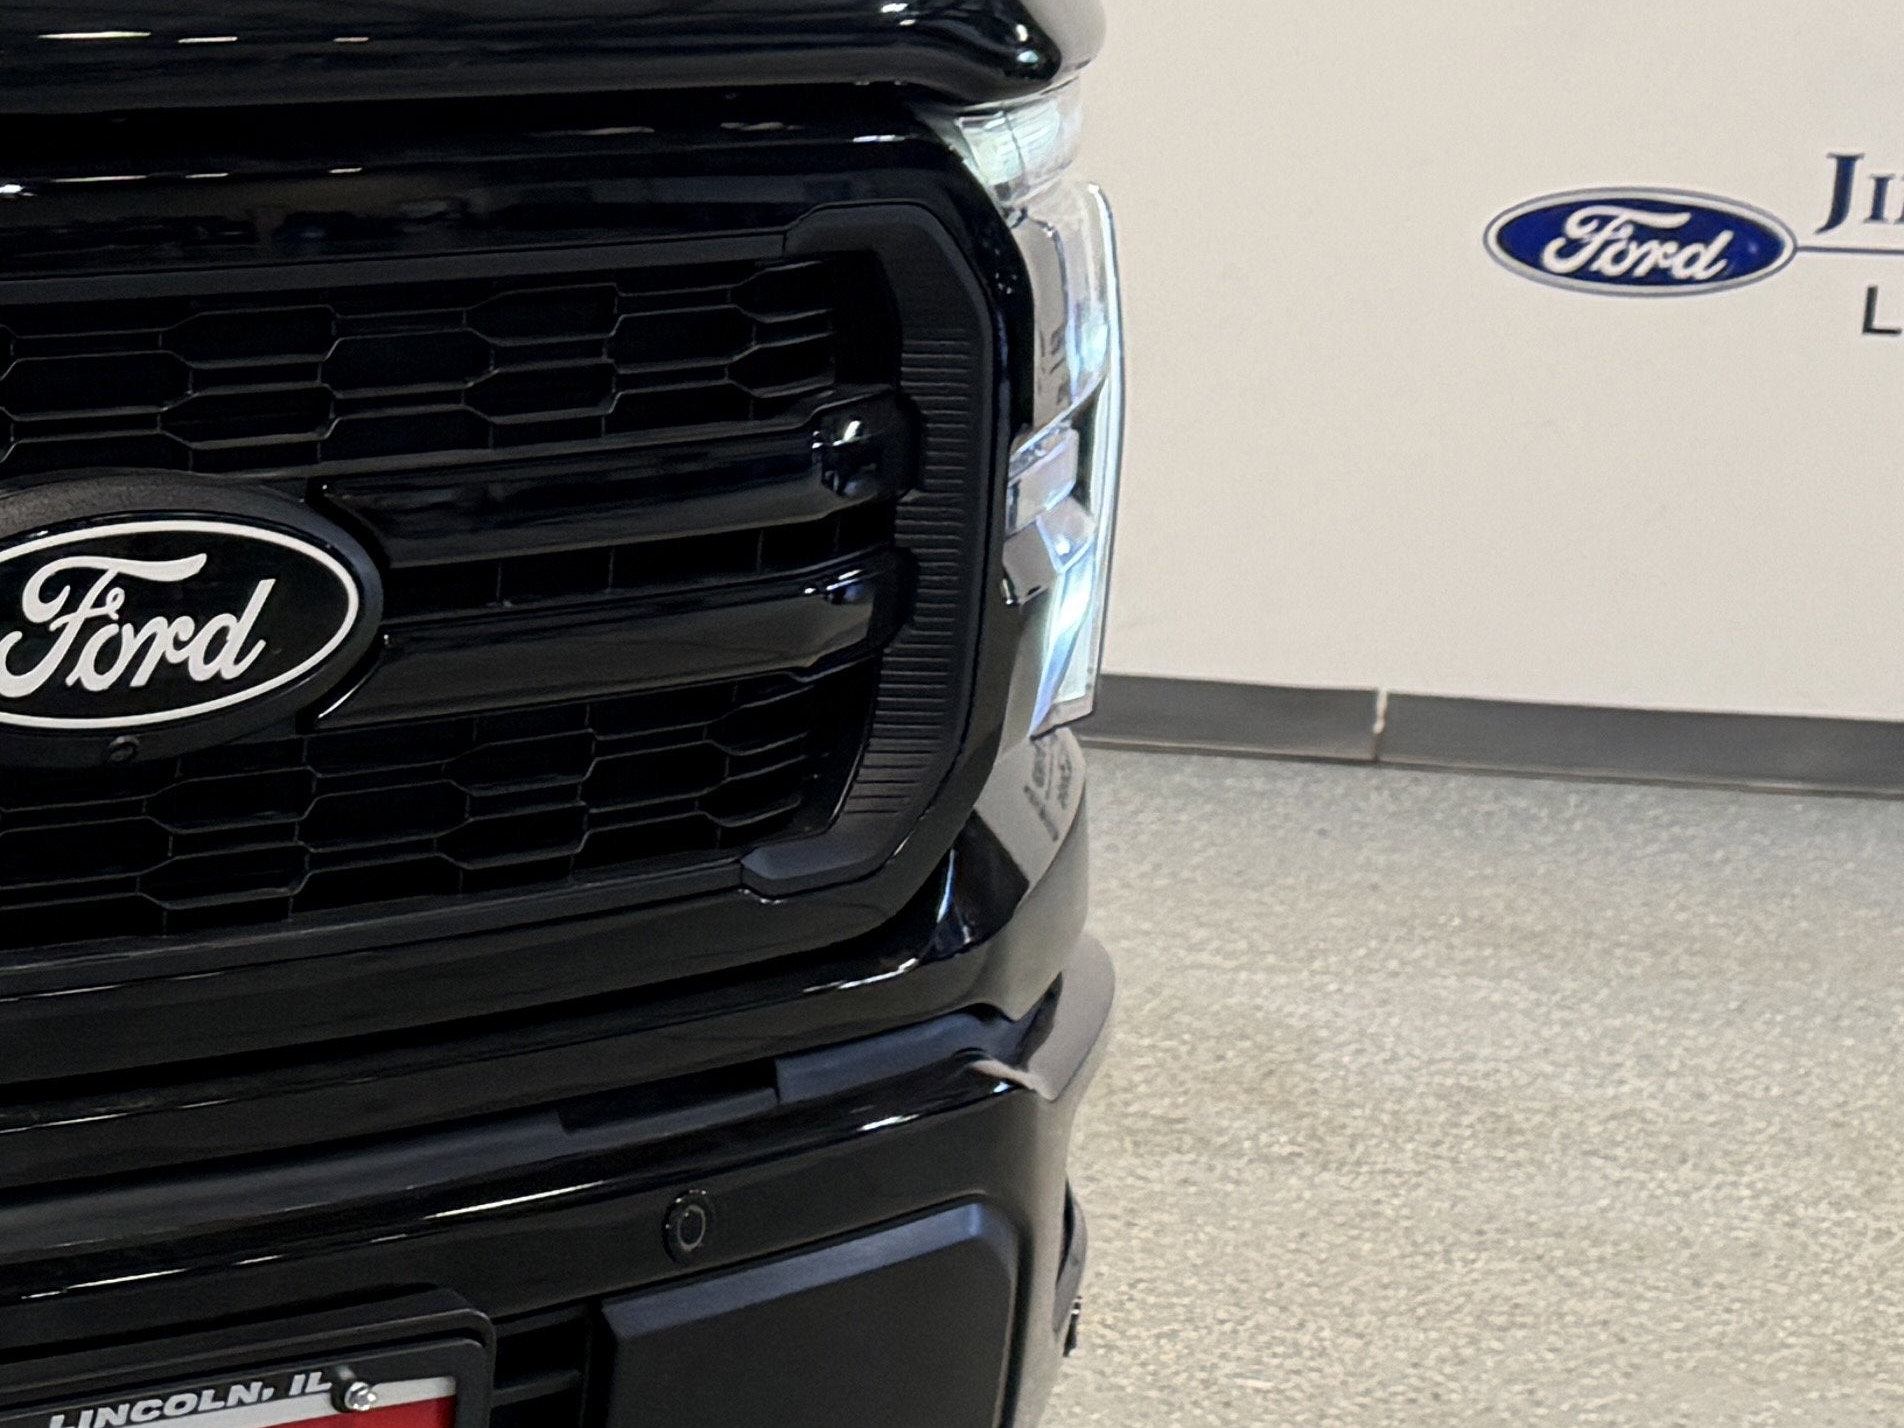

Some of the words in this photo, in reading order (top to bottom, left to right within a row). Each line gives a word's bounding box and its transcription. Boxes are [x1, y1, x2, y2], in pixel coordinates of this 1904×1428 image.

[1814, 152, 1904, 235] JI
[1541, 204, 1735, 281] Ford
[288, 1371, 333, 1397] IL
